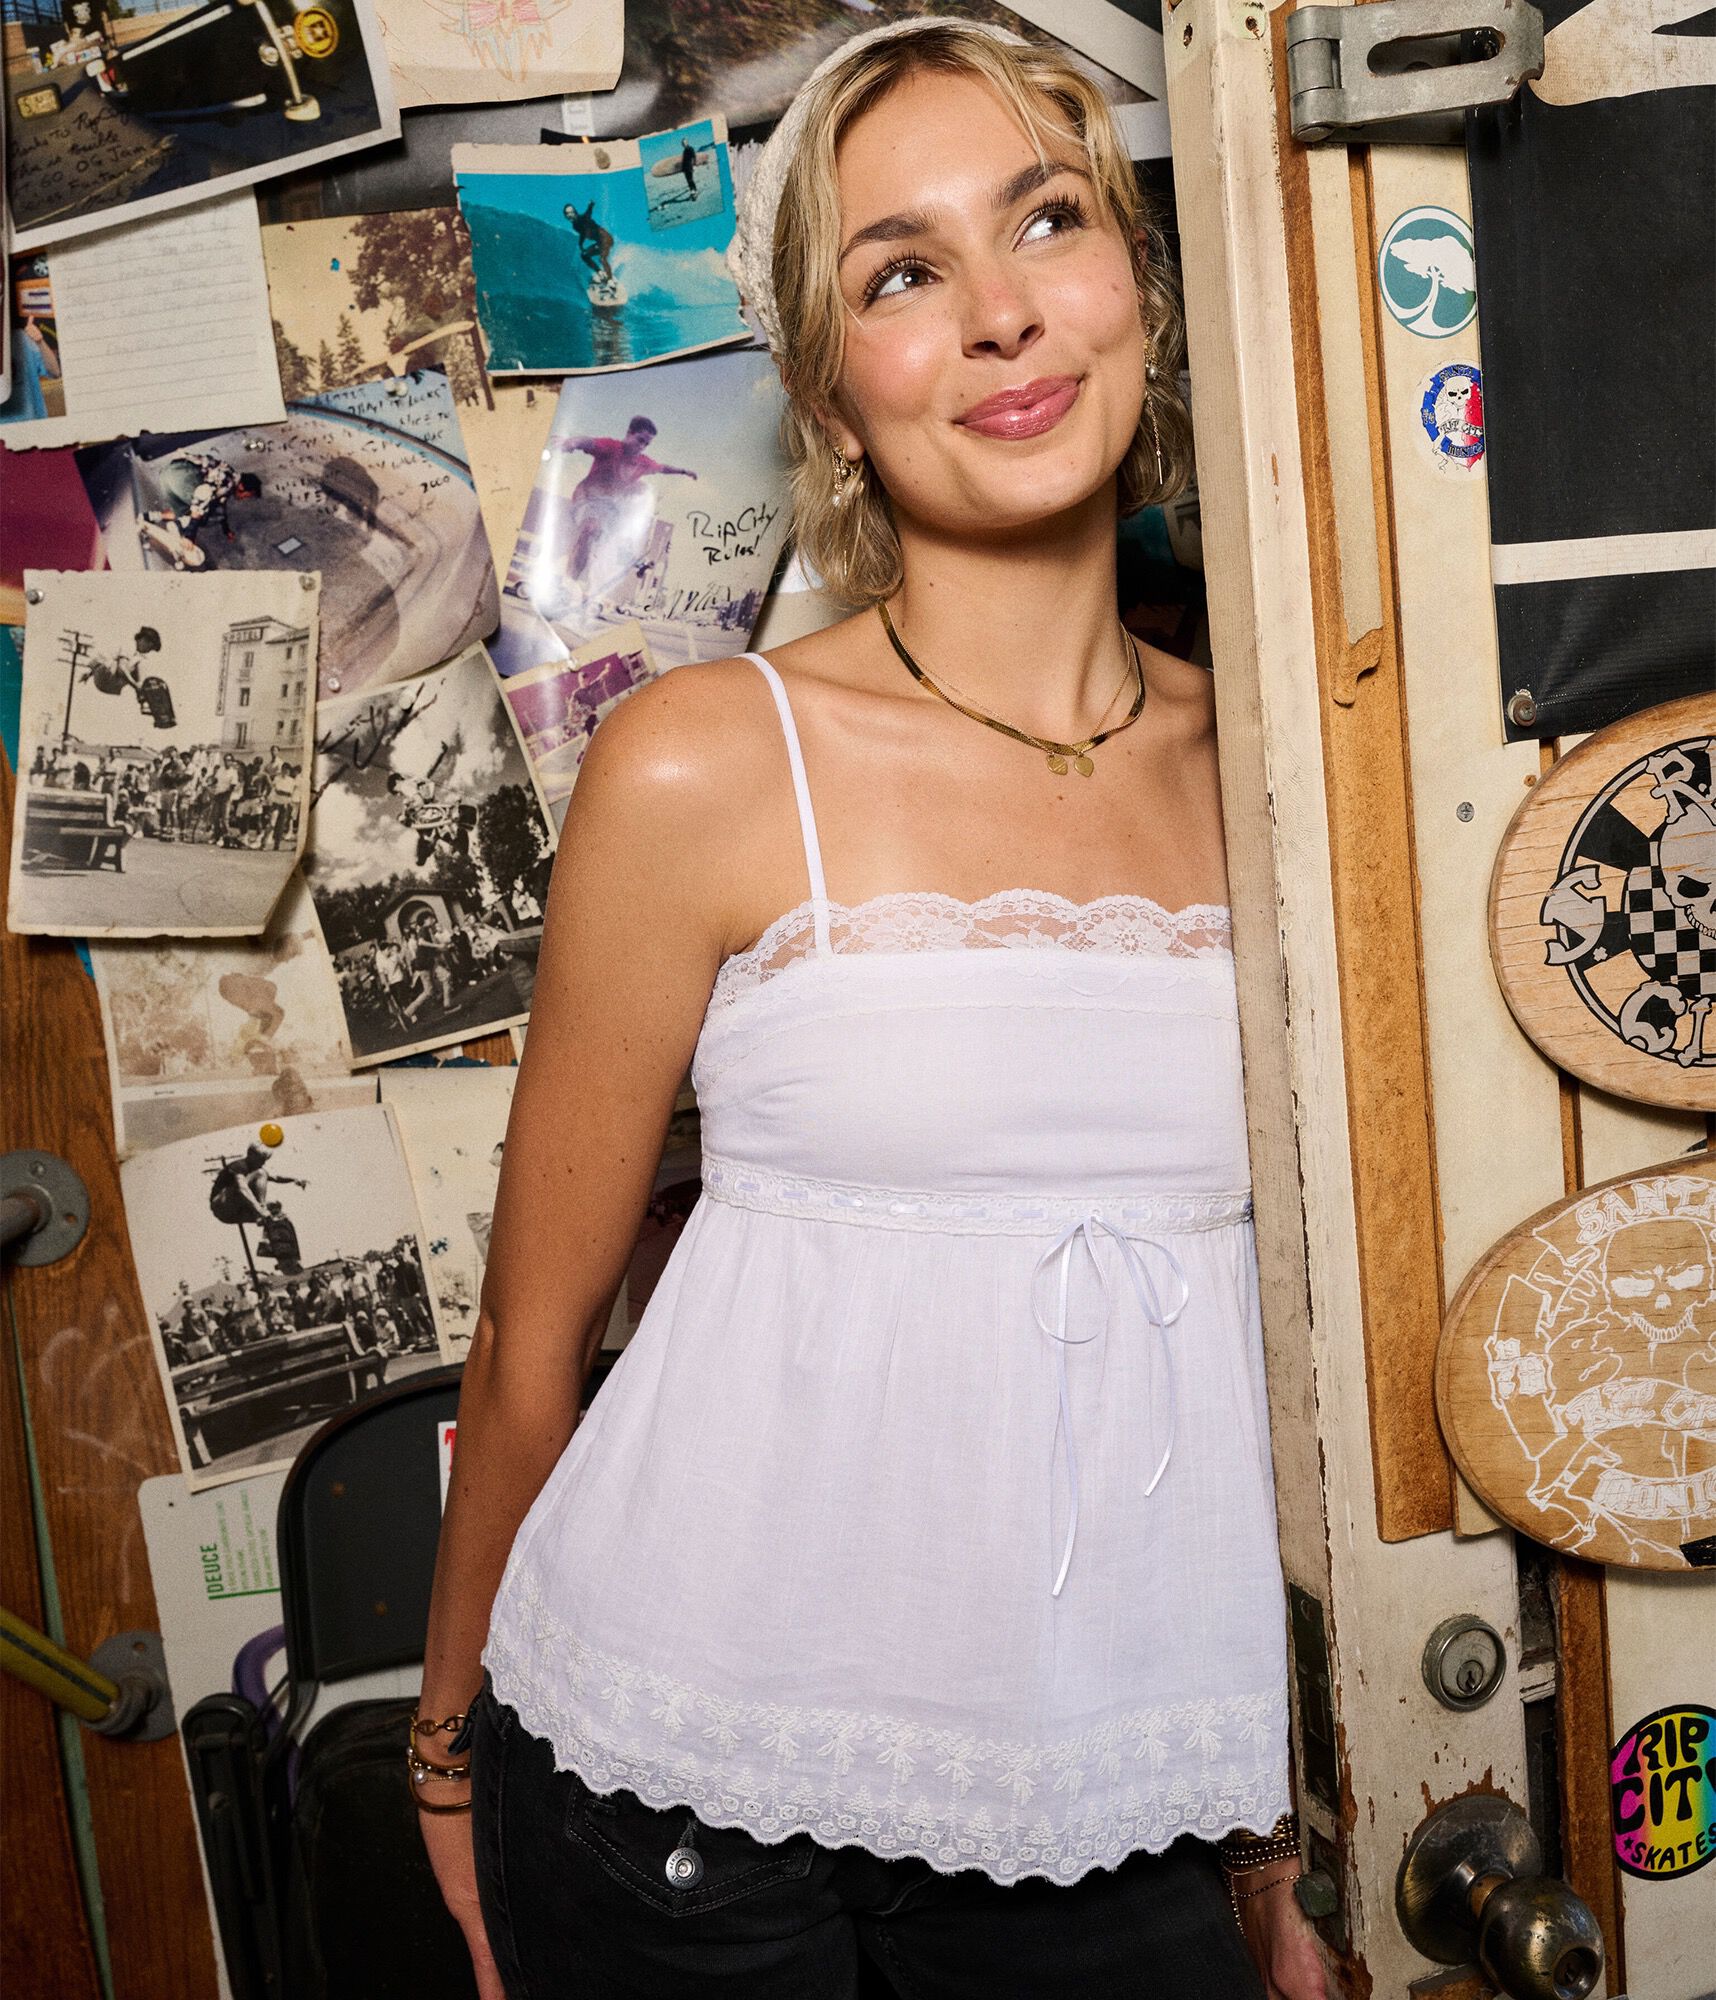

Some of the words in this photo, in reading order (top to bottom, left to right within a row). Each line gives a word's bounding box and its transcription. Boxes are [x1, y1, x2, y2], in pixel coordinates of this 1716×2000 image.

[737, 503, 779, 539] City
[200, 1543, 224, 1594] DEUCE
[1623, 1716, 1709, 1776] RIP
